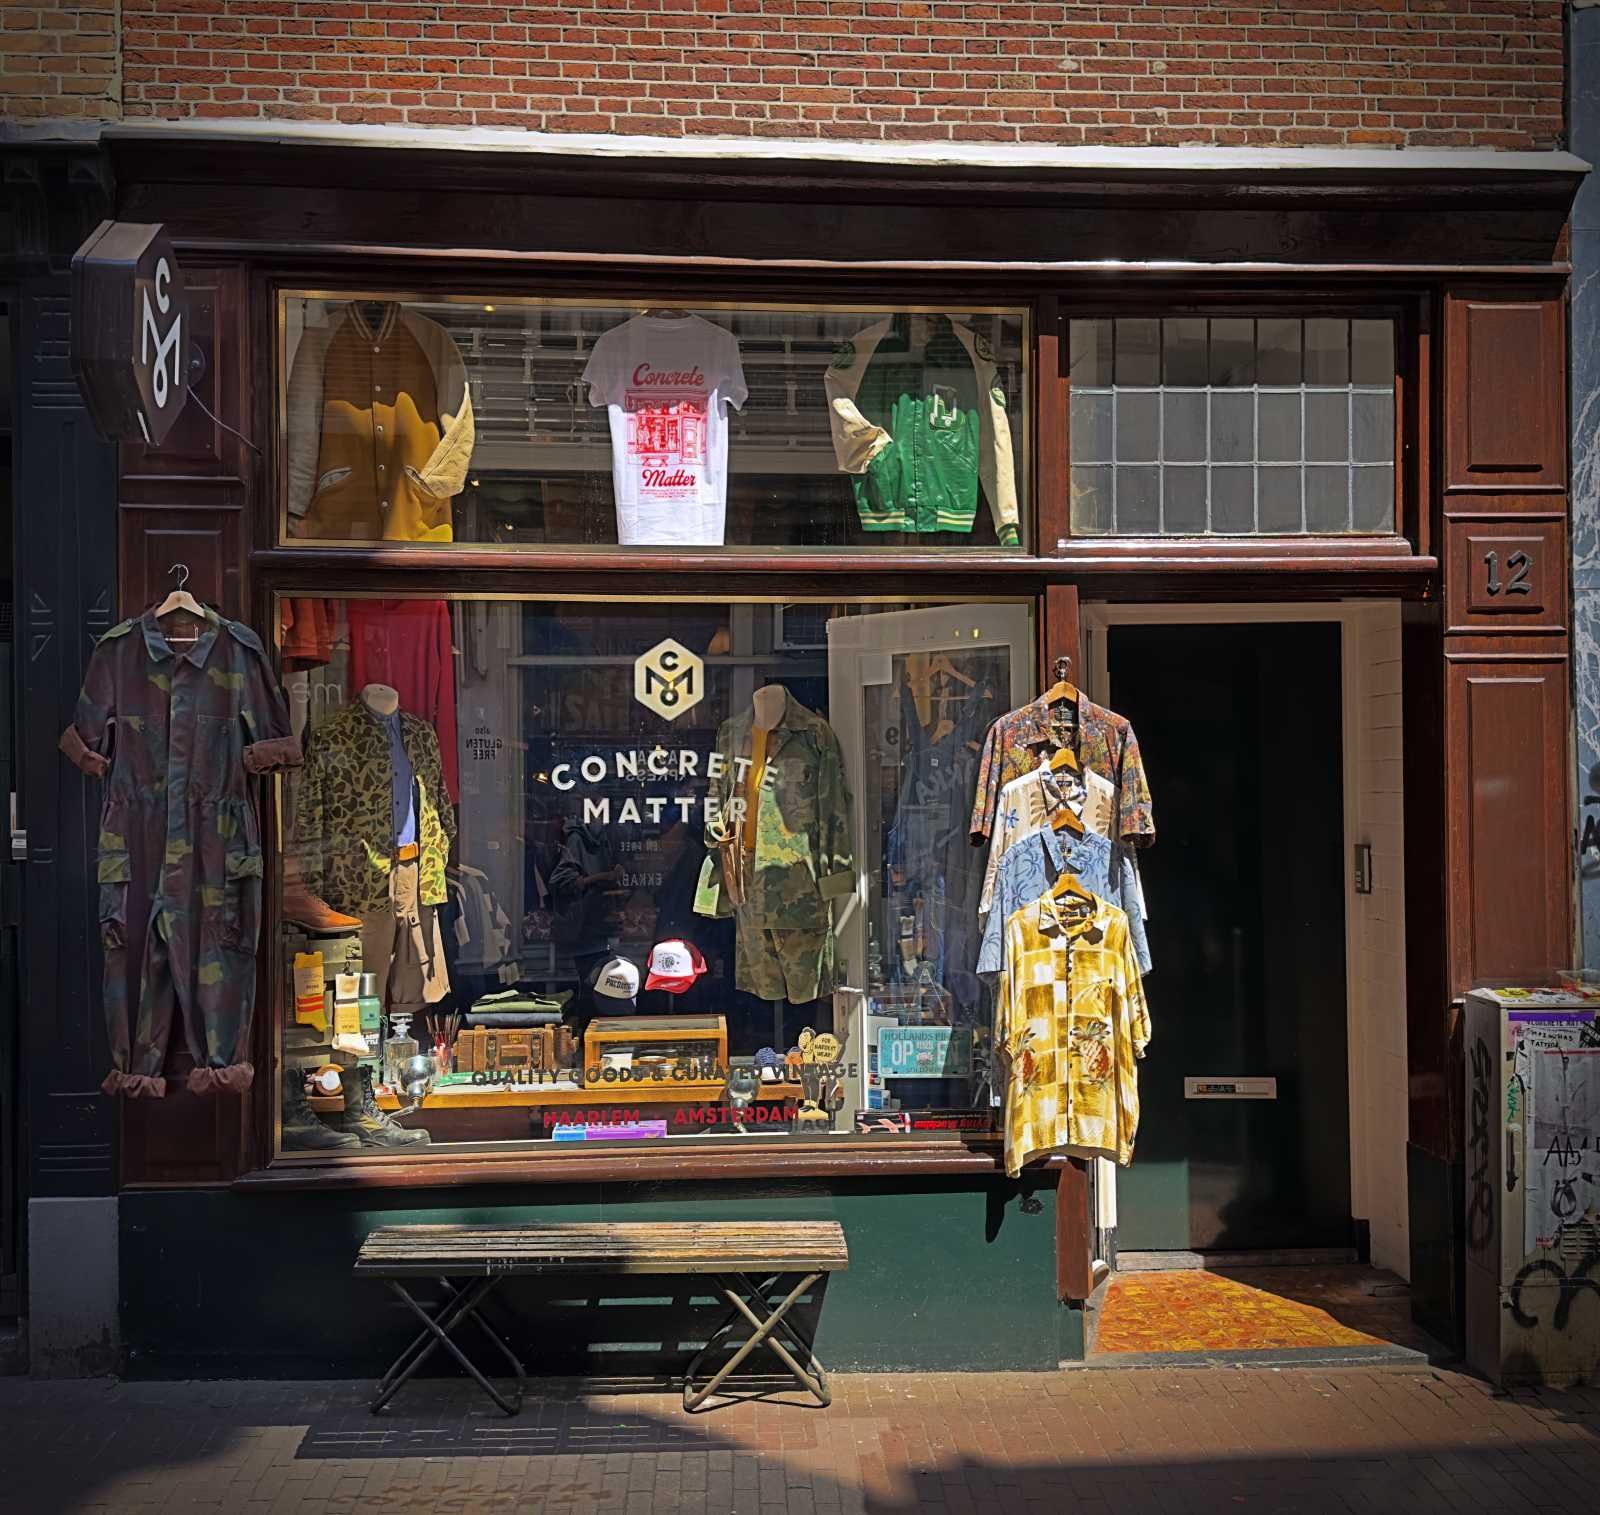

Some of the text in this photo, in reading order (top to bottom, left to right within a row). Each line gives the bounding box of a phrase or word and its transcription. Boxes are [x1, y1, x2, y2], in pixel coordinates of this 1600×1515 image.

[632, 362, 705, 387] Concrete
[641, 469, 697, 487] Matter
[1484, 549, 1533, 596] 12
[551, 750, 780, 791] CONCRETE
[583, 797, 748, 825] MATTER
[891, 1043, 914, 1066] OP
[472, 1069, 558, 1085] QUALITY
[569, 1066, 642, 1083] GOODS
[671, 1064, 762, 1082] CURAED
[674, 1106, 800, 1124] AMSTERDAM
